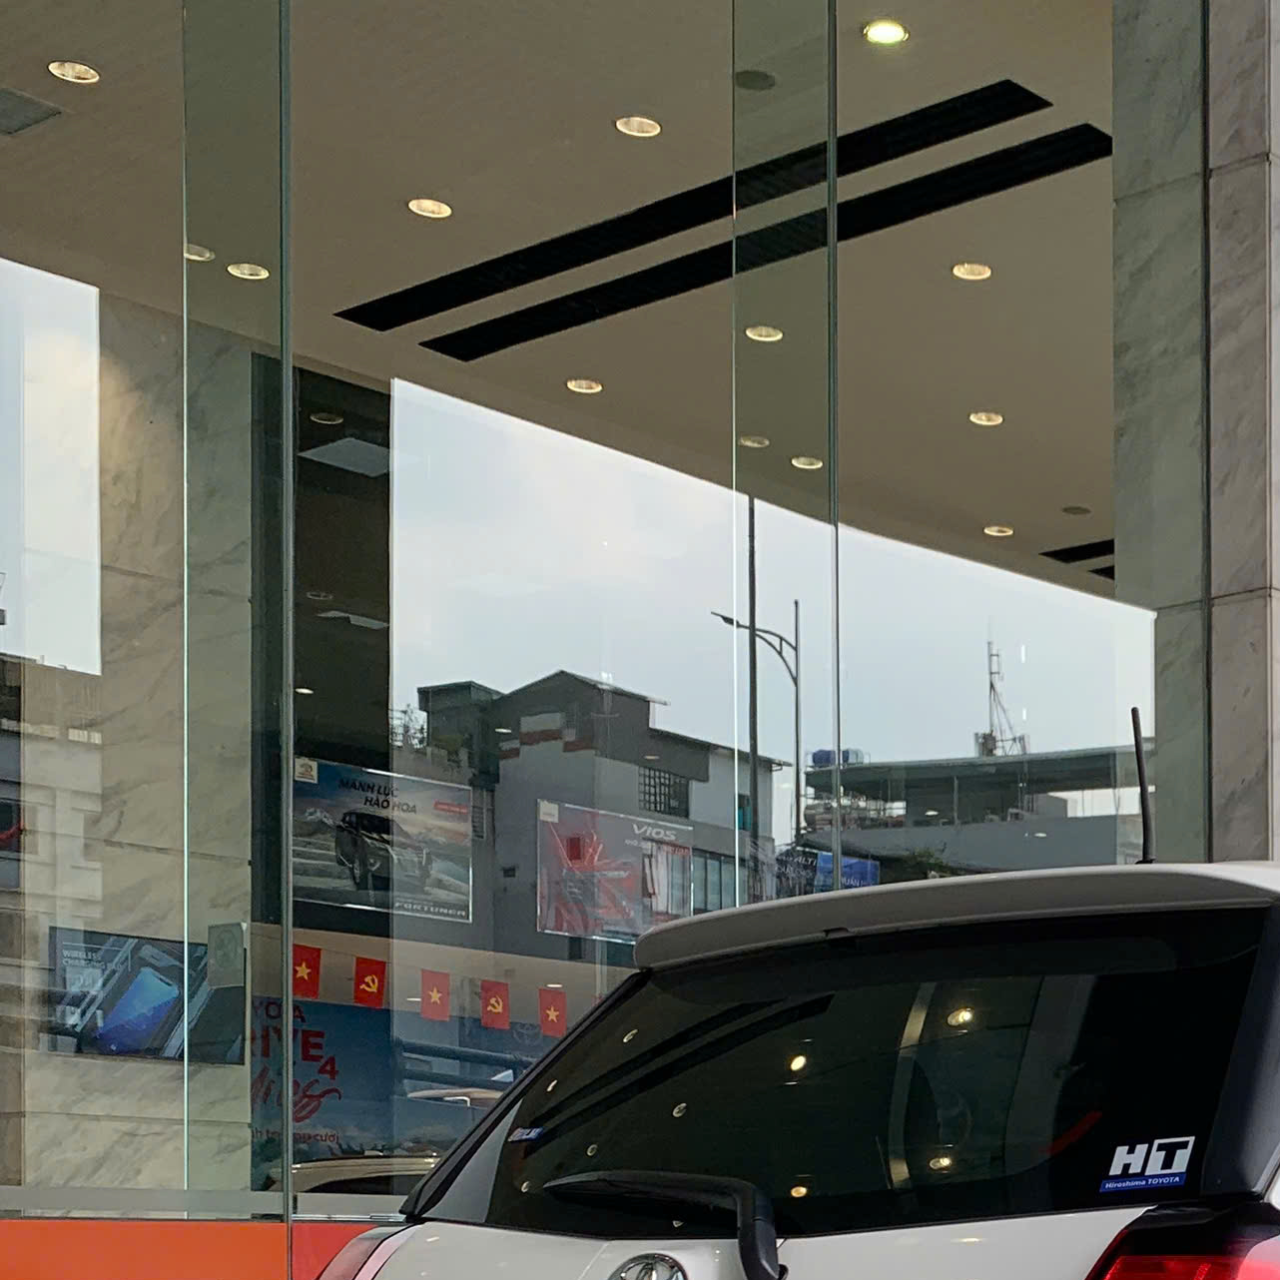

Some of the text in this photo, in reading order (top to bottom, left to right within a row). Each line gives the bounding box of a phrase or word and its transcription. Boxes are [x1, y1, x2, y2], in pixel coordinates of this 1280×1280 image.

[632, 823, 677, 841] VIOS
[1109, 1136, 1195, 1176] HT
[1105, 1176, 1180, 1189] Hiroshima TOYOTA
